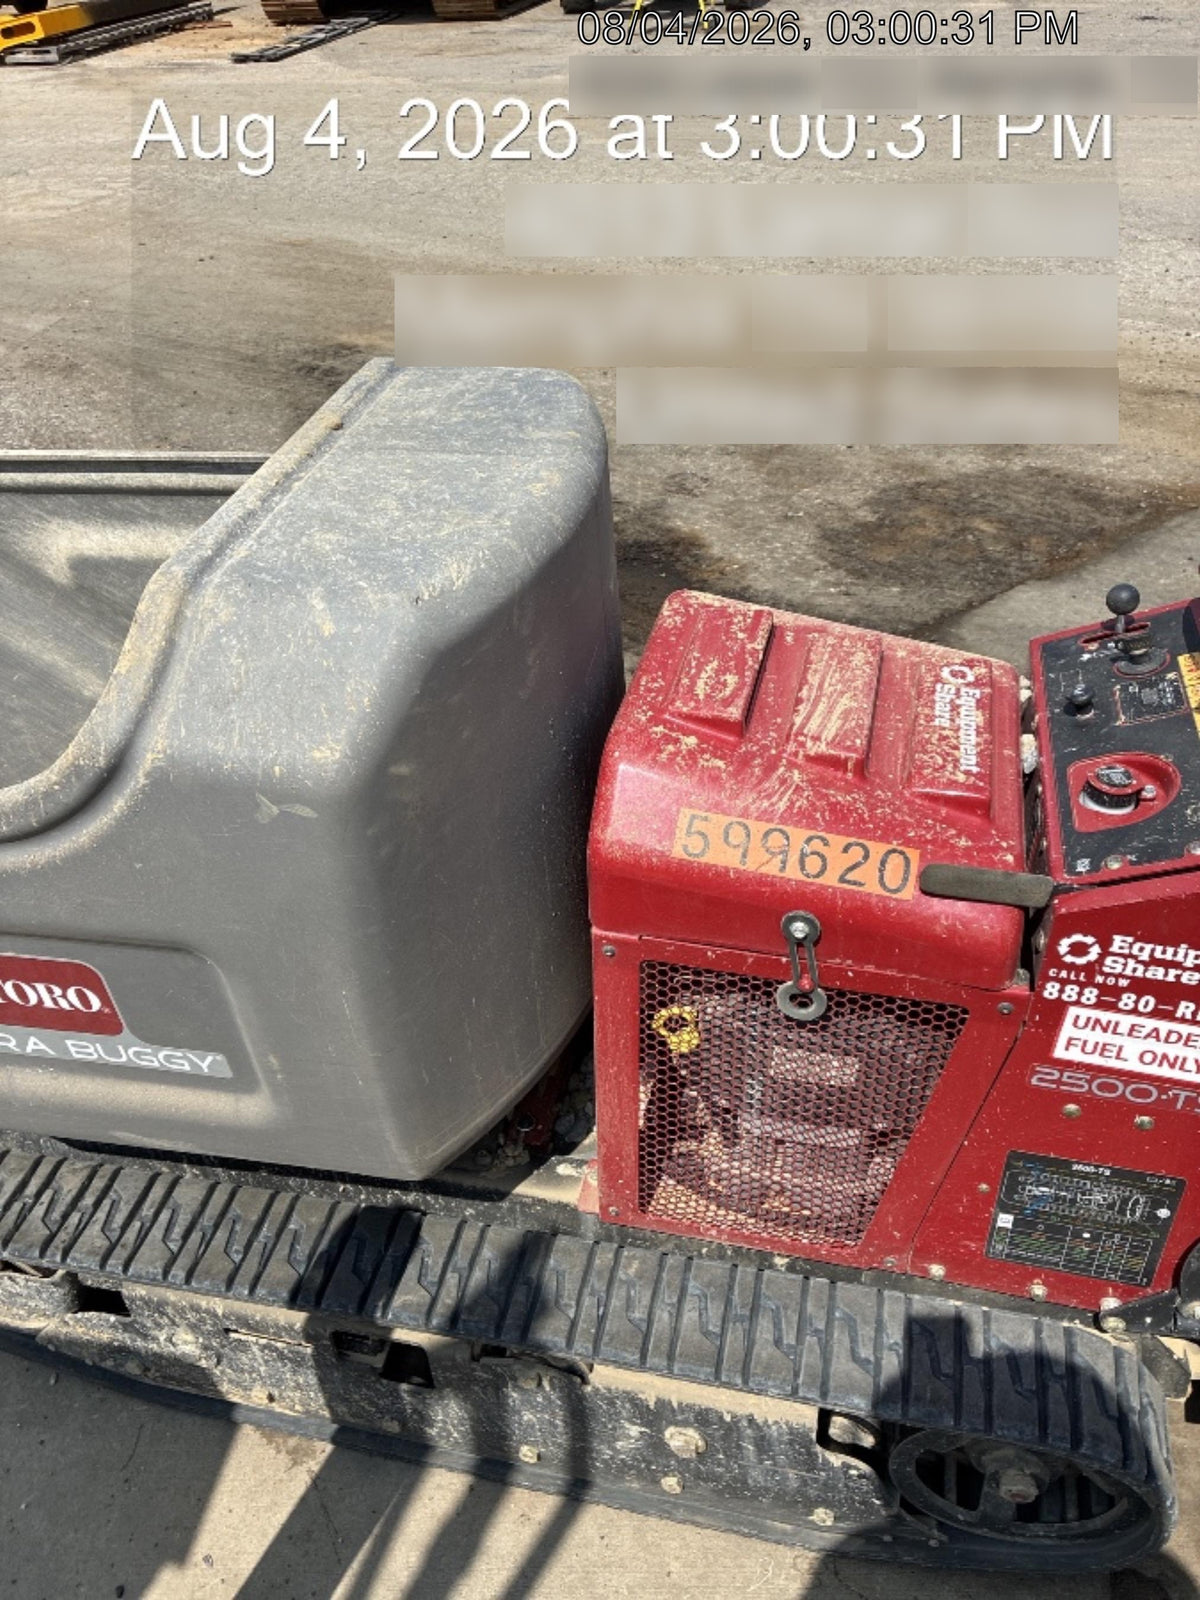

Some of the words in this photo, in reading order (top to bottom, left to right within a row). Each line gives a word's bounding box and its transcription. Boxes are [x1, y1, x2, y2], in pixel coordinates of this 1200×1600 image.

[955, 687, 981, 774] Equipment
[681, 813, 912, 895] 599620
[1108, 934, 1200, 968] Equip
[1048, 968, 1087, 982] CALL
[1094, 974, 1131, 988] NOW
[1101, 956, 1200, 985] Share
[0, 979, 102, 1014] ORO
[1042, 981, 1200, 1020] 888-80-R
[64, 1039, 216, 1073] BUGGY
[1064, 1036, 1129, 1062] FUEL
